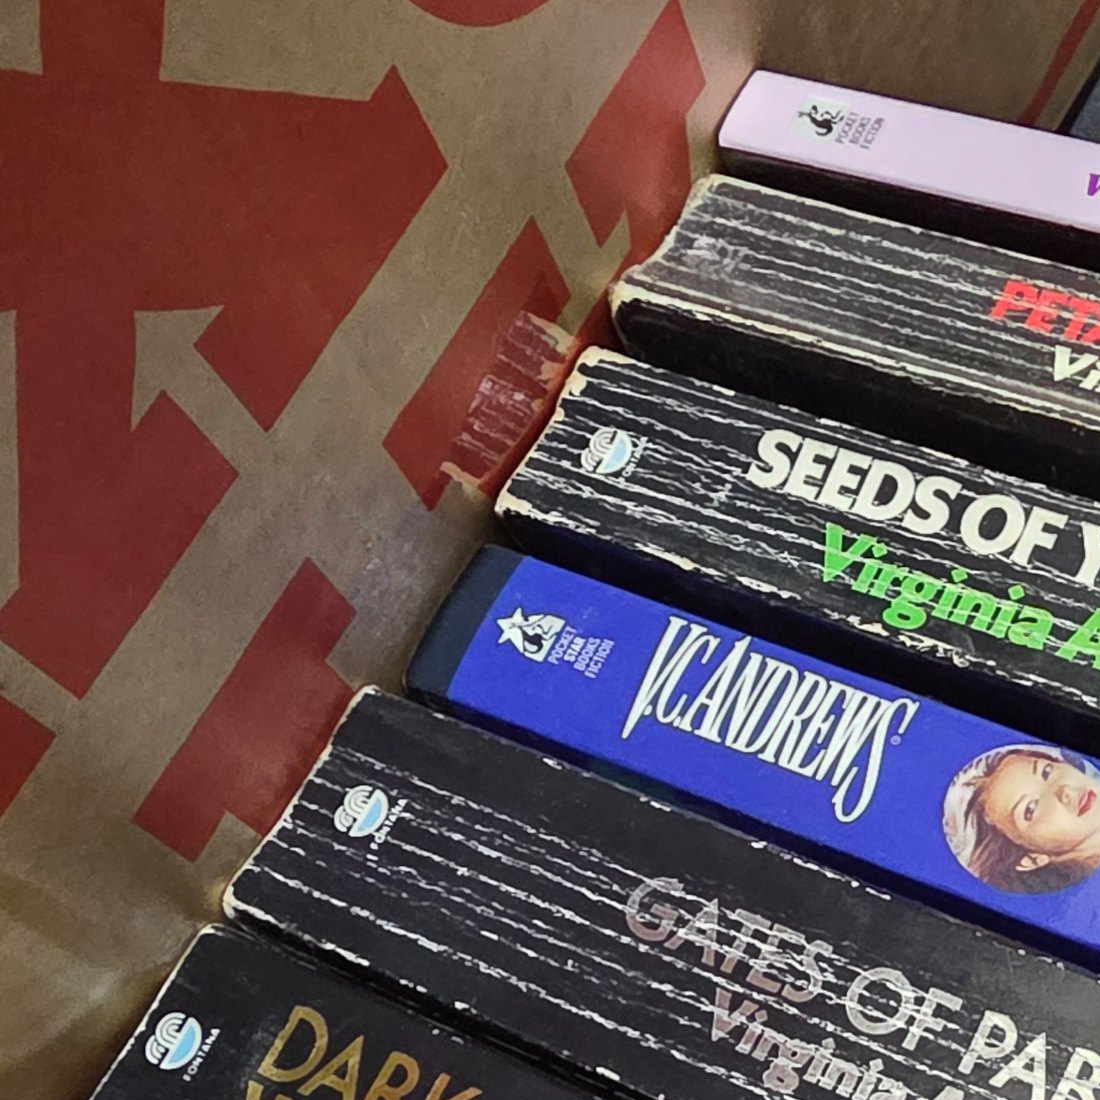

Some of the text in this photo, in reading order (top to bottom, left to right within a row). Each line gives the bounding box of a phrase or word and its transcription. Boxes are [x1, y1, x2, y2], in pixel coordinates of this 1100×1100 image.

[746, 428, 964, 534] SEEDS
[959, 496, 1068, 567] OF
[822, 522, 1052, 650] Virginia
[547, 626, 577, 664] POCKET
[563, 637, 586, 662] STAR
[573, 637, 601, 671] BOOKS
[584, 639, 615, 678] FICTION
[625, 876, 836, 1003] GATES
[844, 967, 963, 1050] OF
[182, 1028, 221, 1081] FONTANA
